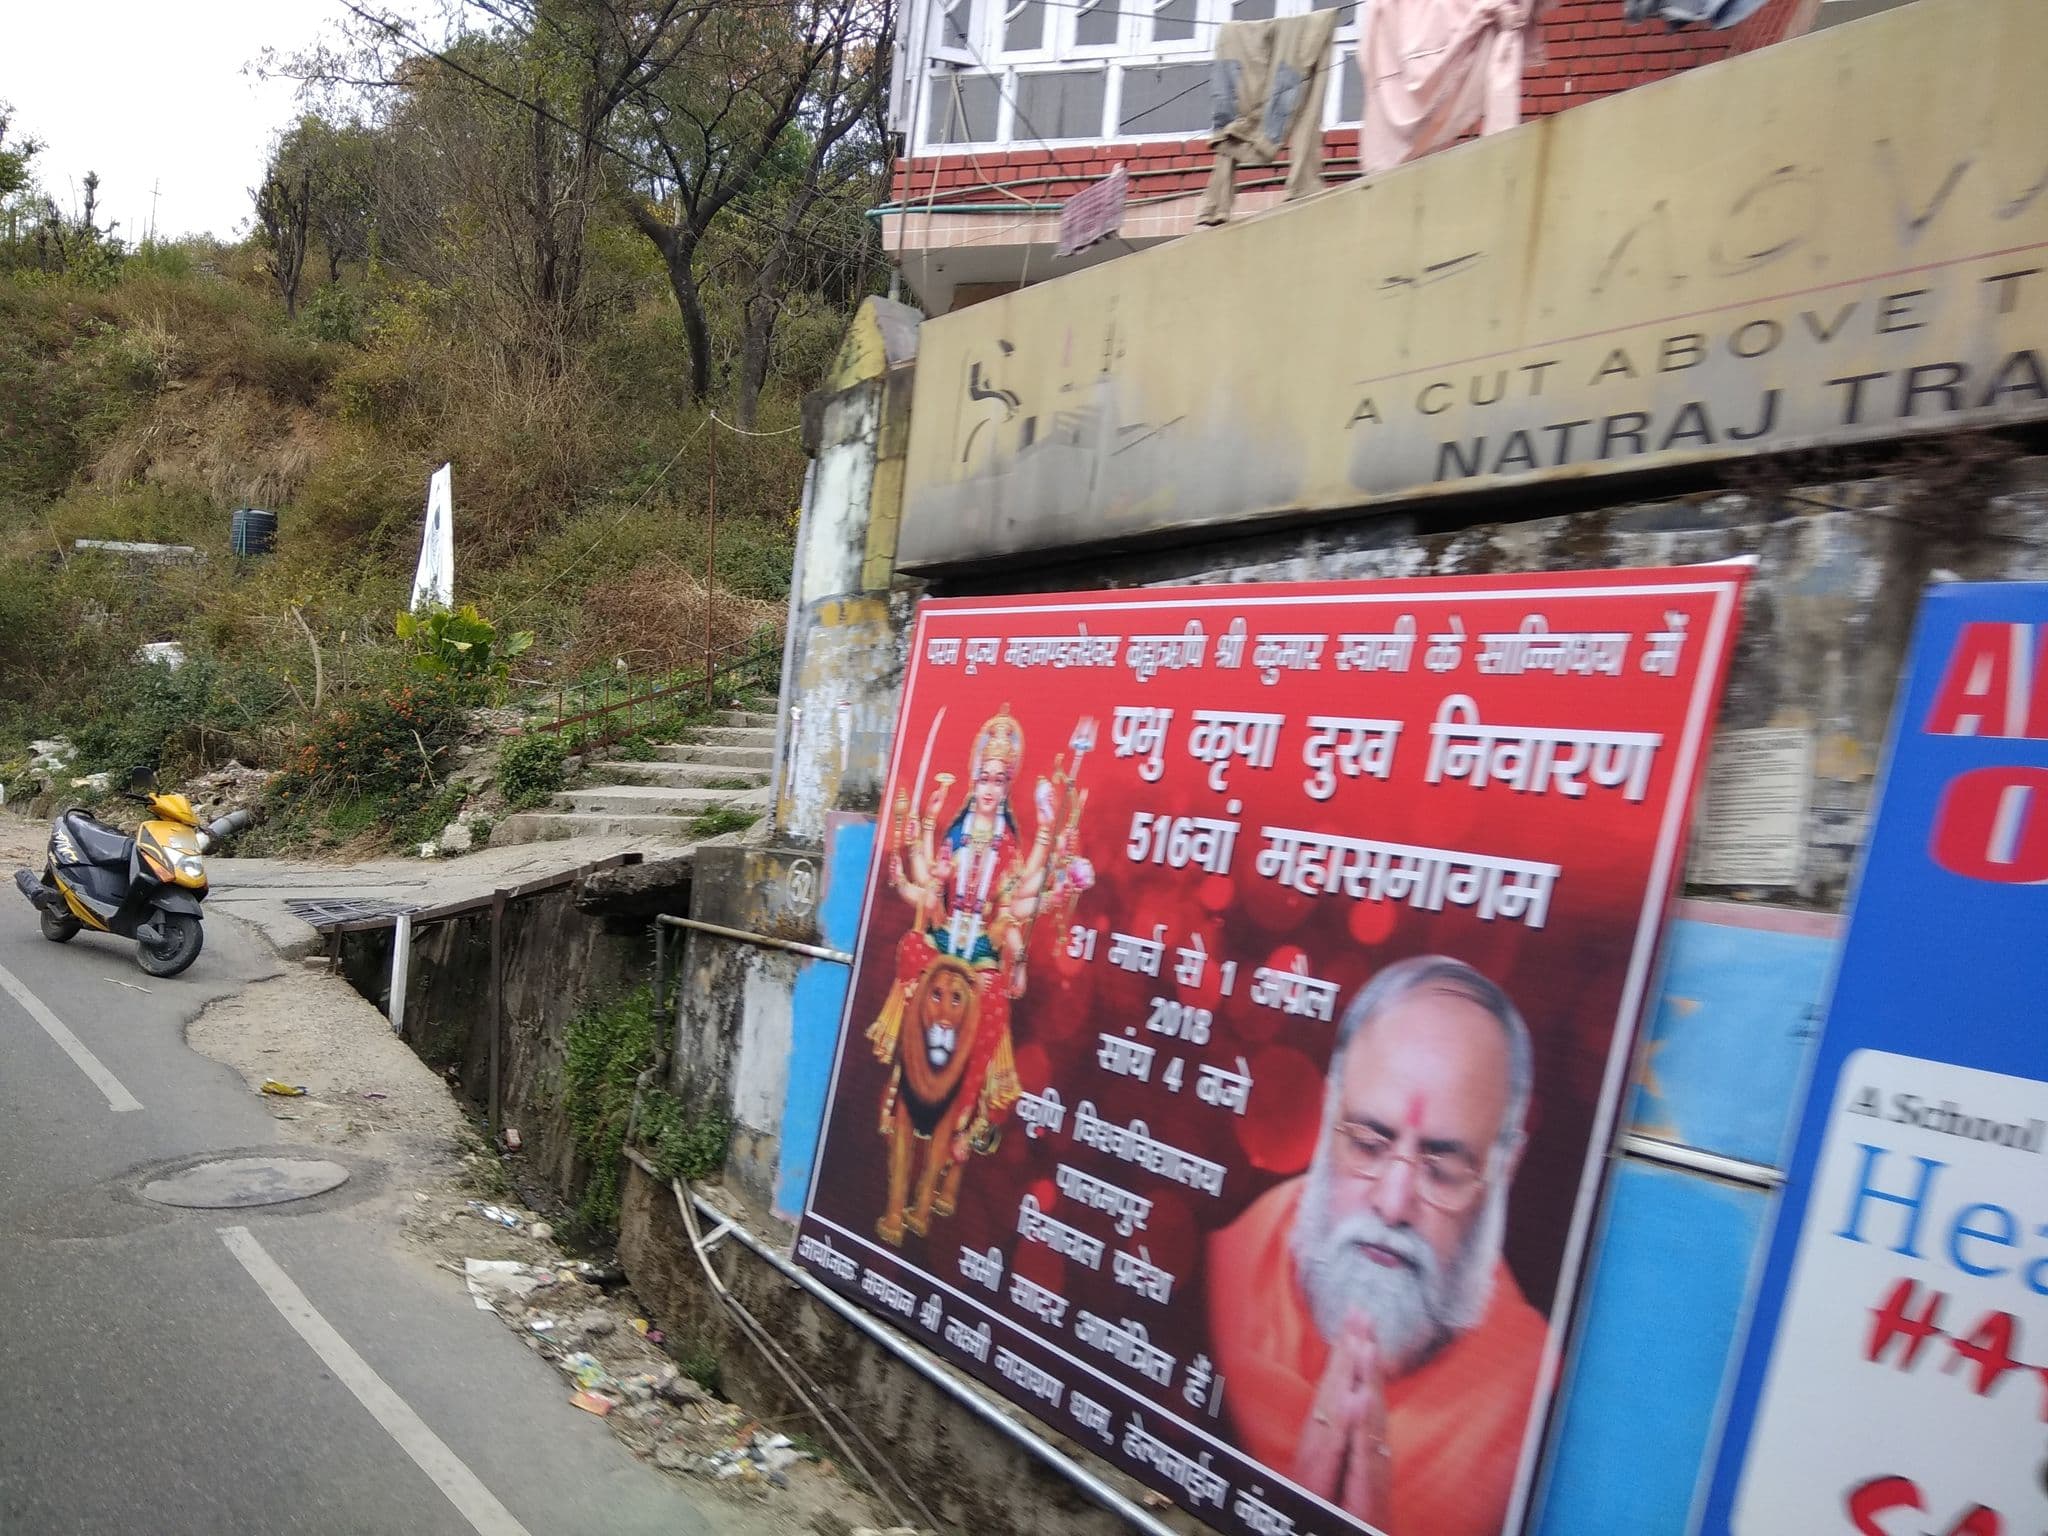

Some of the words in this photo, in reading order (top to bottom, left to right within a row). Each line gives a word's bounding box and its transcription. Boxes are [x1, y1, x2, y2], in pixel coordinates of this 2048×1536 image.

[1346, 398, 1384, 430] A
[1415, 358, 1559, 416] CUT
[1588, 286, 1932, 386] ABOVE
[1433, 388, 1786, 484] NATRAJ
[1214, 616, 1248, 670] श्री
[1253, 633, 1329, 686] कुमार
[1335, 614, 1418, 673] स्वामी
[1424, 615, 1467, 674] के
[1640, 609, 1690, 678] में
[1111, 705, 1175, 781] प्रभु
[1187, 708, 1286, 791] कृपा
[1302, 714, 1405, 800] दुख
[1424, 693, 1664, 802] निवारण
[1255, 824, 1563, 930] महासमागम
[1066, 924, 1098, 961] 31
[1107, 923, 1168, 978] मार्च
[1173, 931, 1208, 989] से
[1219, 960, 1238, 996] 1
[1145, 996, 1214, 1046] 2018
[1015, 1086, 1067, 1139] कृषि
[1162, 1056, 1186, 1093] 4
[1195, 1055, 1254, 1116] बजे
[1848, 1086, 1881, 1119] A
[1887, 1093, 2046, 1154] School
[1055, 1162, 1155, 1238] पालमपुर
[1016, 1193, 1106, 1271] हिमाचल
[1112, 1244, 1176, 1305] प्रदेश
[918, 1293, 944, 1334] श्री
[957, 1246, 1004, 1293] सभी
[1008, 1272, 1071, 1329] सादर
